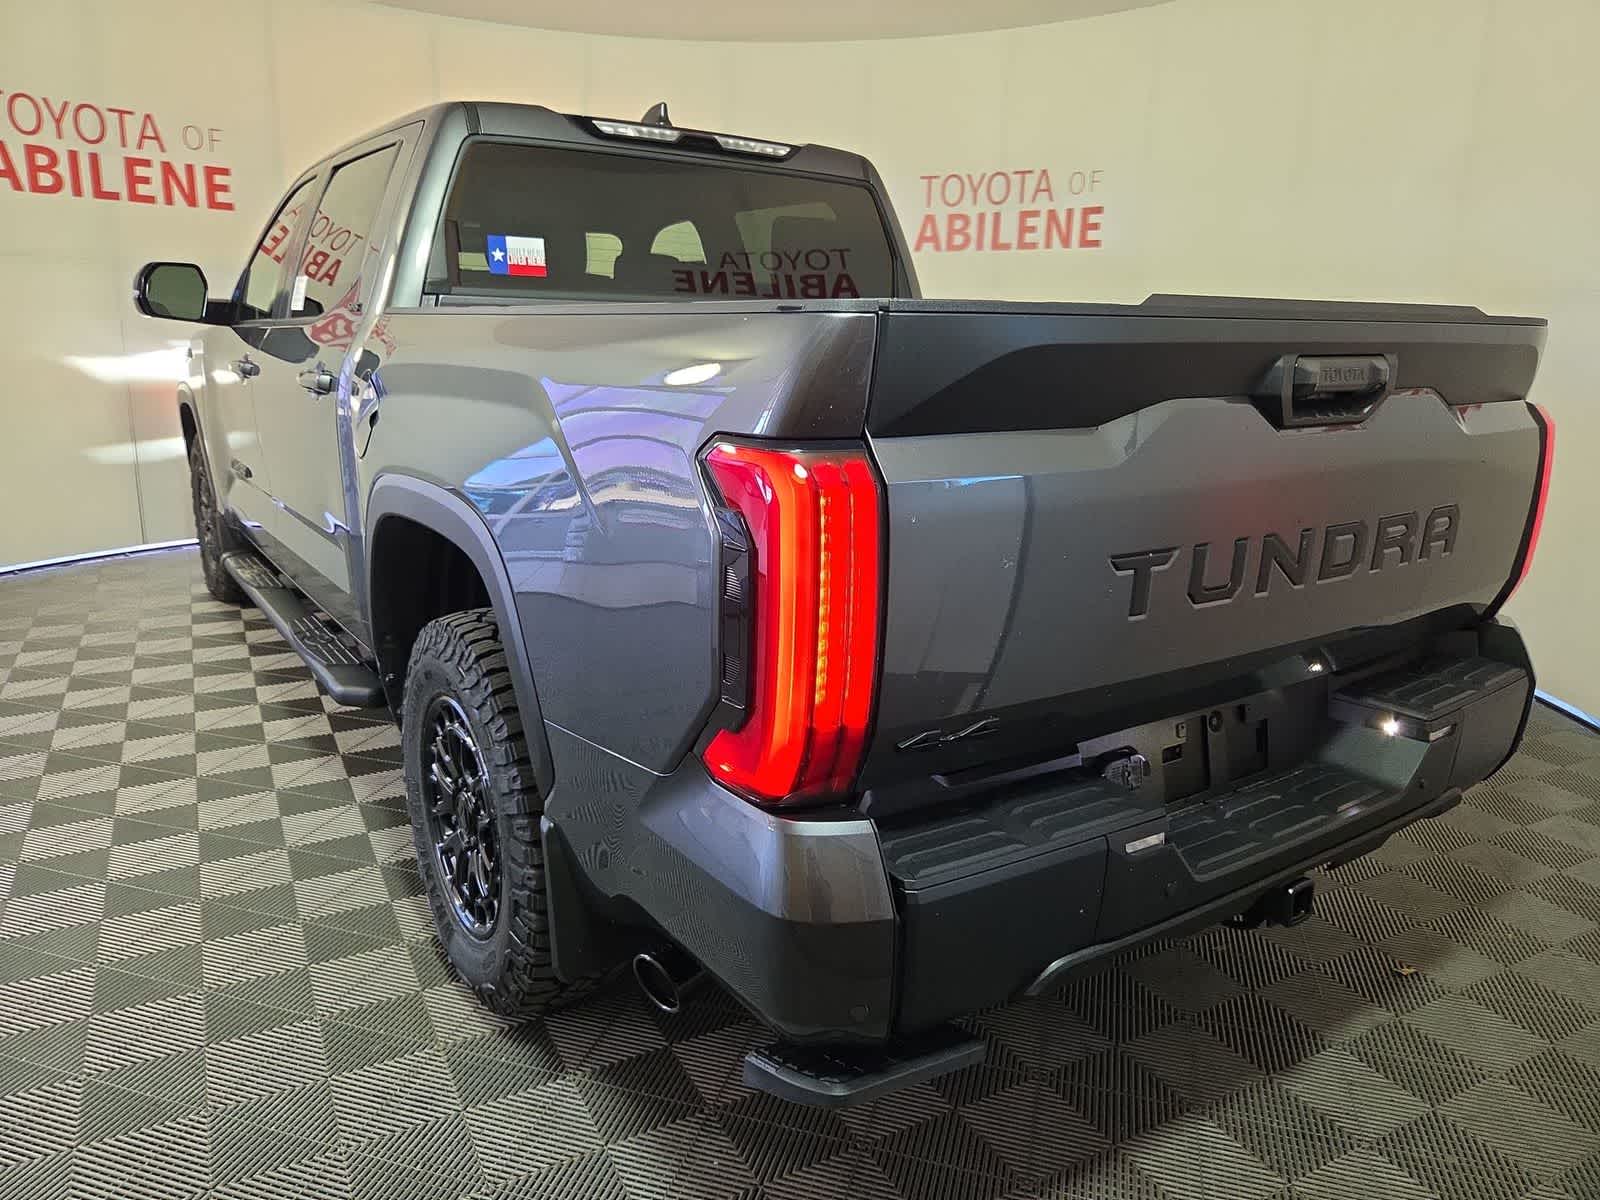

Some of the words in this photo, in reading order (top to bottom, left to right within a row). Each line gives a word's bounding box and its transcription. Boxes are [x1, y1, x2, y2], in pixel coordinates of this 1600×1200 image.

[0, 89, 167, 153] OYOTA
[182, 124, 224, 152] OF
[919, 168, 1054, 208] TOYOTA
[1069, 169, 1105, 195] OF
[914, 206, 1105, 252] ABILENE
[1108, 504, 1460, 621] TUNDRA
